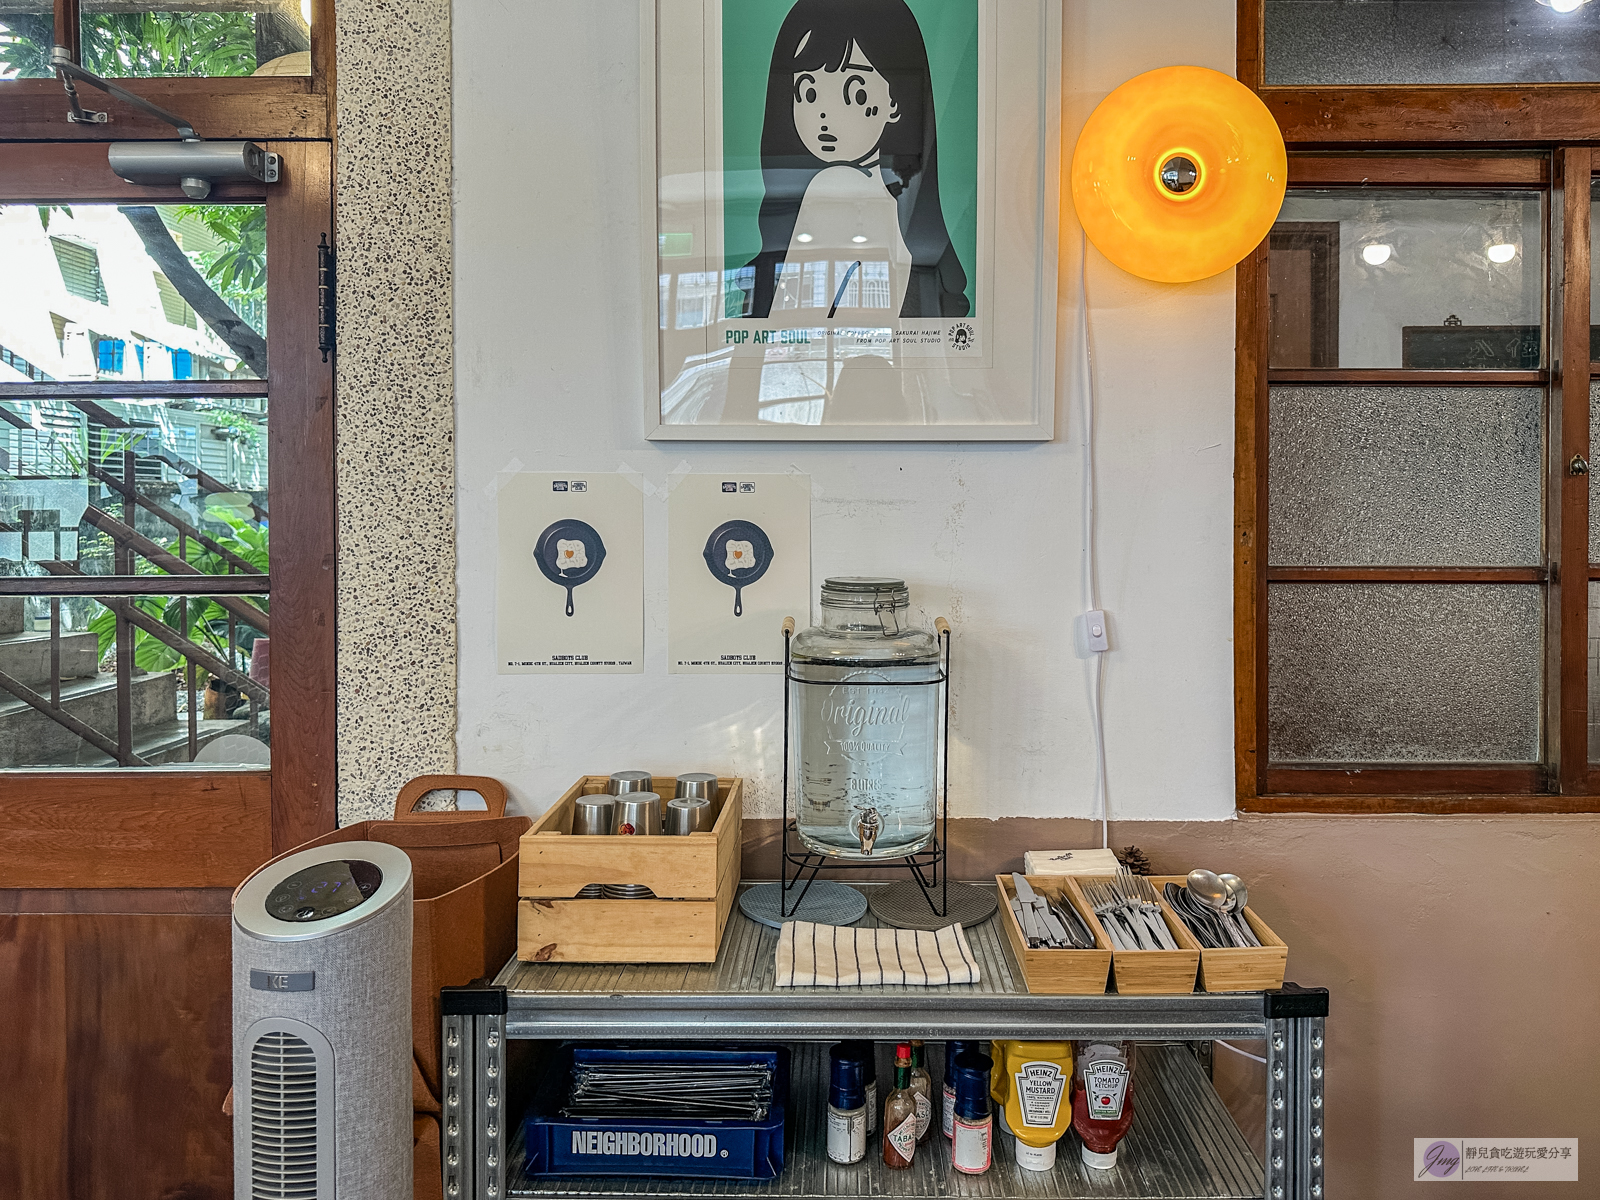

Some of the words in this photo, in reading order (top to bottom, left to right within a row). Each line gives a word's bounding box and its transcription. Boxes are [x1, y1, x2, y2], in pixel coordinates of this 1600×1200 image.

[725, 330, 749, 344] POP
[753, 330, 777, 344] ART
[780, 330, 811, 344] SOUL
[821, 695, 910, 737] Original
[860, 741, 890, 752] QUALITY
[267, 975, 289, 989] KE
[1030, 1069, 1053, 1077] HEINZ
[1096, 1065, 1118, 1074] HEINZ
[1026, 1086, 1056, 1094] MUSTARD
[572, 1131, 717, 1157] NEIGHBORHOOD
